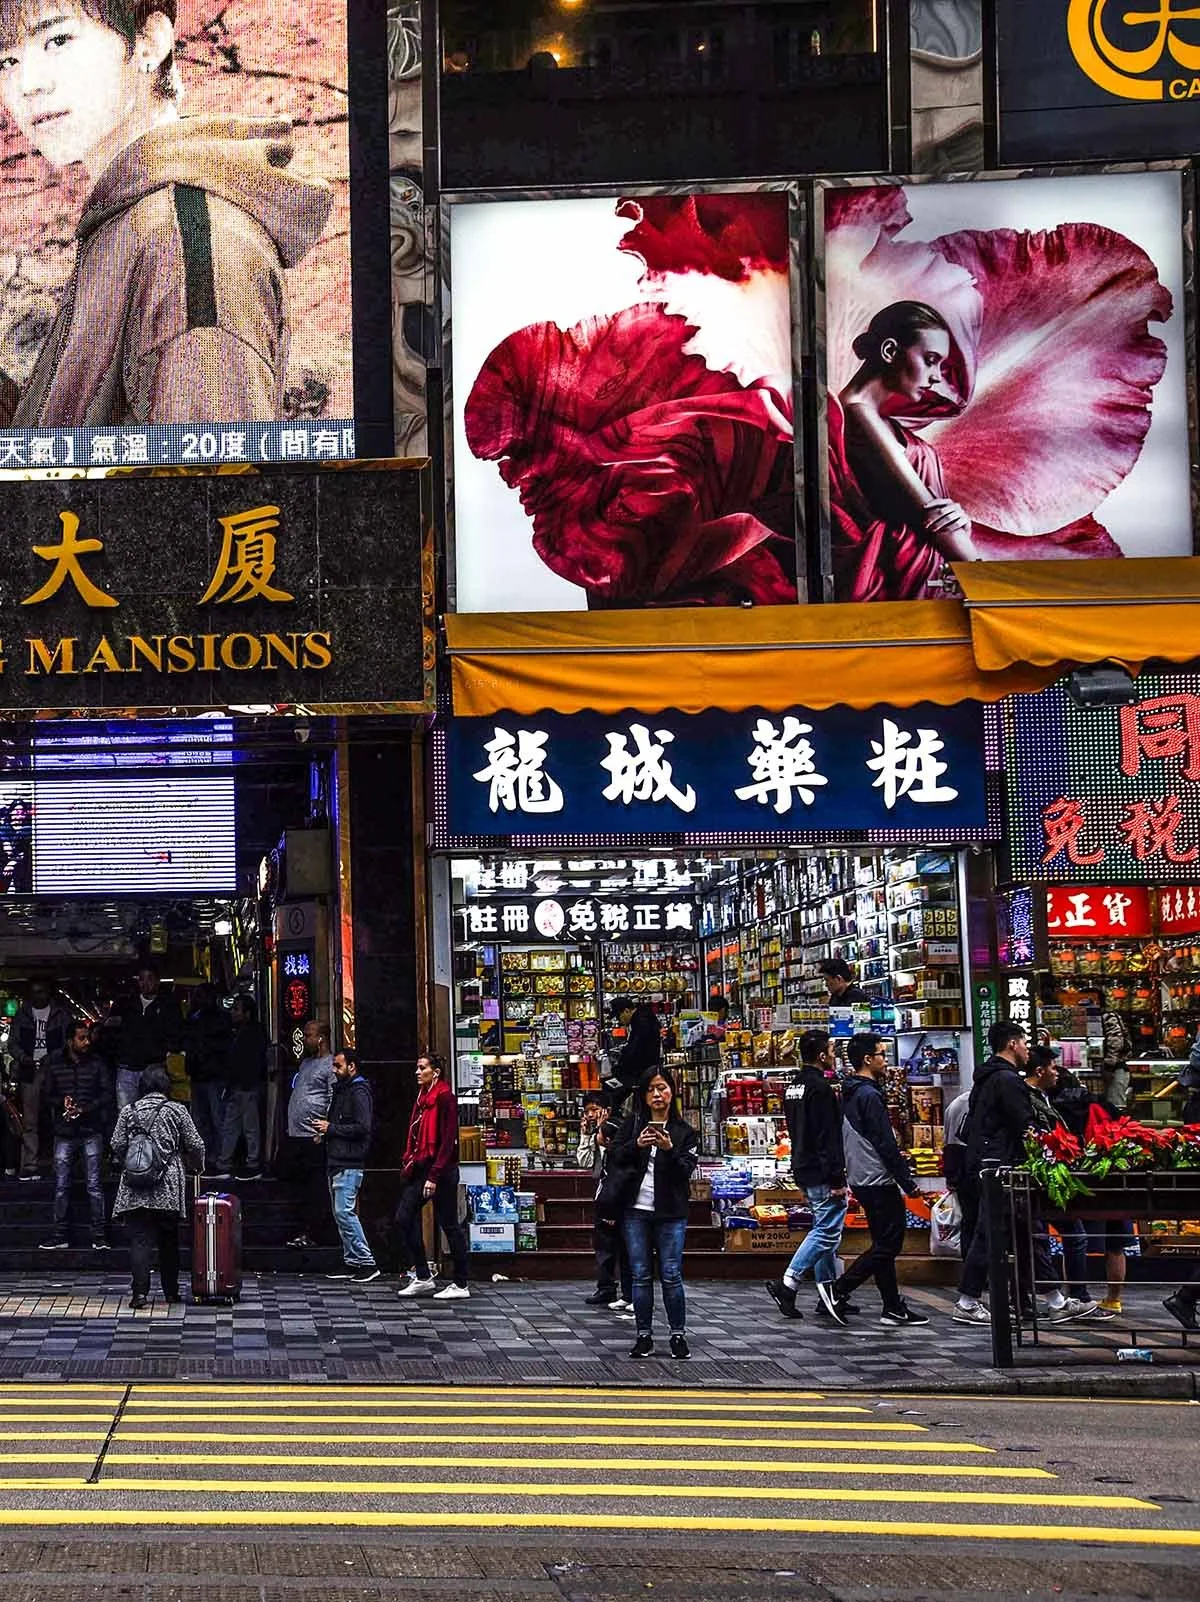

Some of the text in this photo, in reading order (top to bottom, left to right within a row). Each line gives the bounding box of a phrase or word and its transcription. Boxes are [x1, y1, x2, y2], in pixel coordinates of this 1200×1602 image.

[24, 631, 332, 676] MANSIONS
[472, 716, 959, 815] 龍城藥粧
